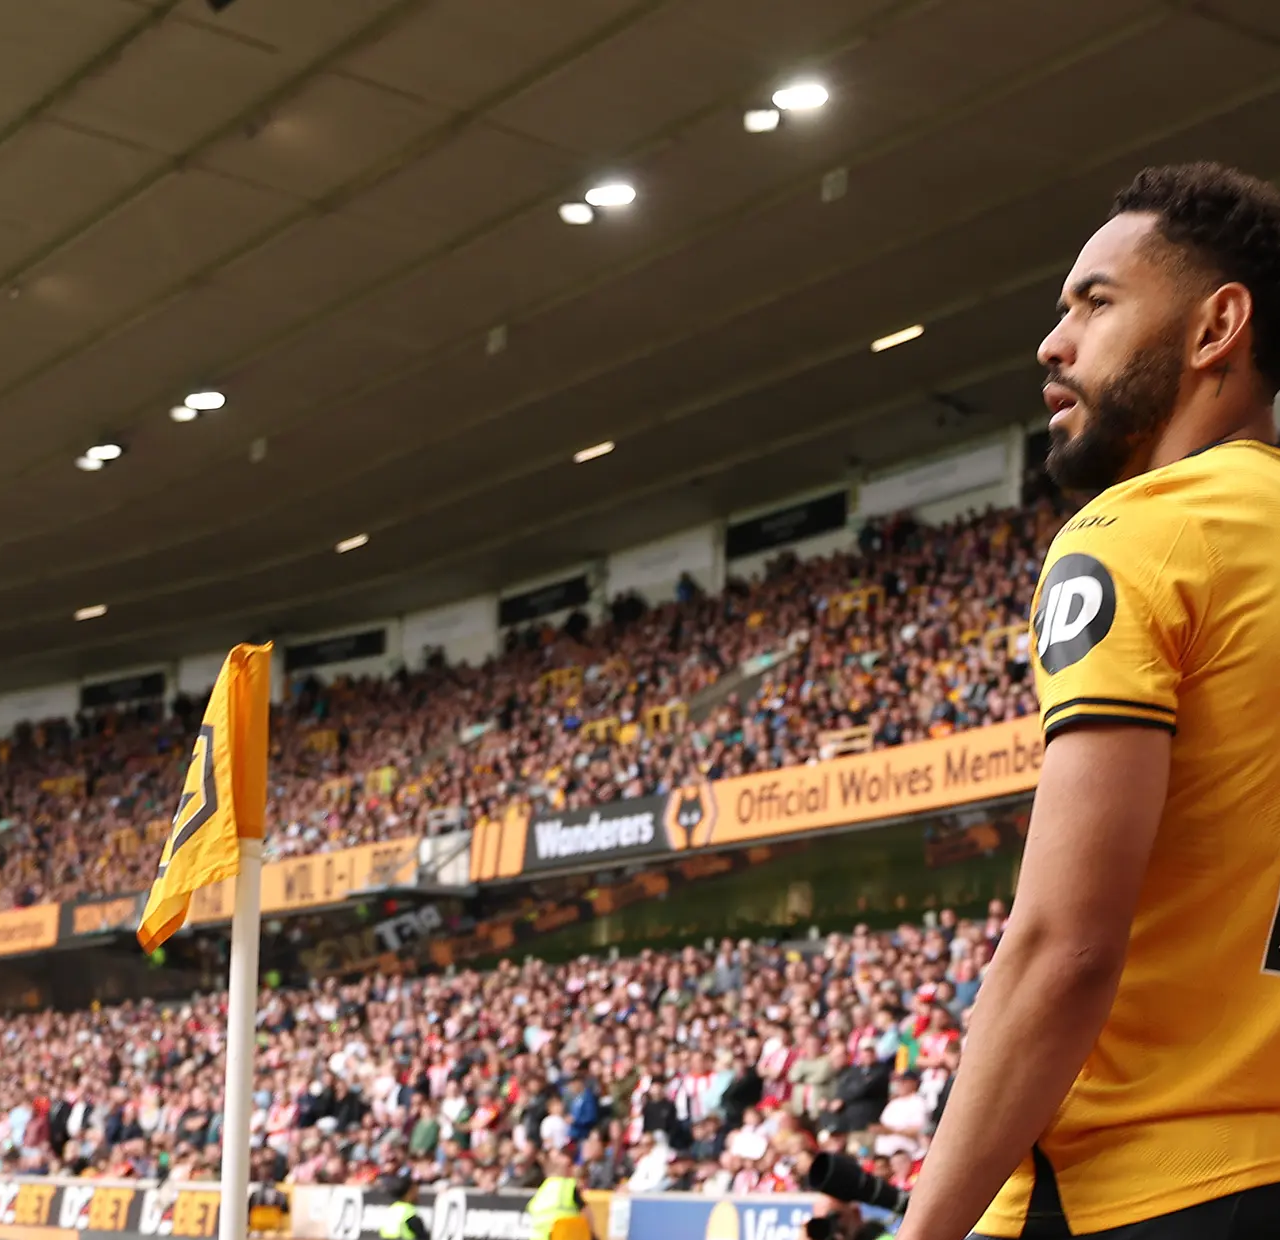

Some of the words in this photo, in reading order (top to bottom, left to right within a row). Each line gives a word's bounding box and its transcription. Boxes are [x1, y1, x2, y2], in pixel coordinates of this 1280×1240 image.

[1038, 575, 1104, 659] JD
[534, 809, 655, 860] Wanderers
[736, 771, 829, 825] Official
[837, 759, 934, 807] Wolves
[943, 732, 1044, 789] Membe
